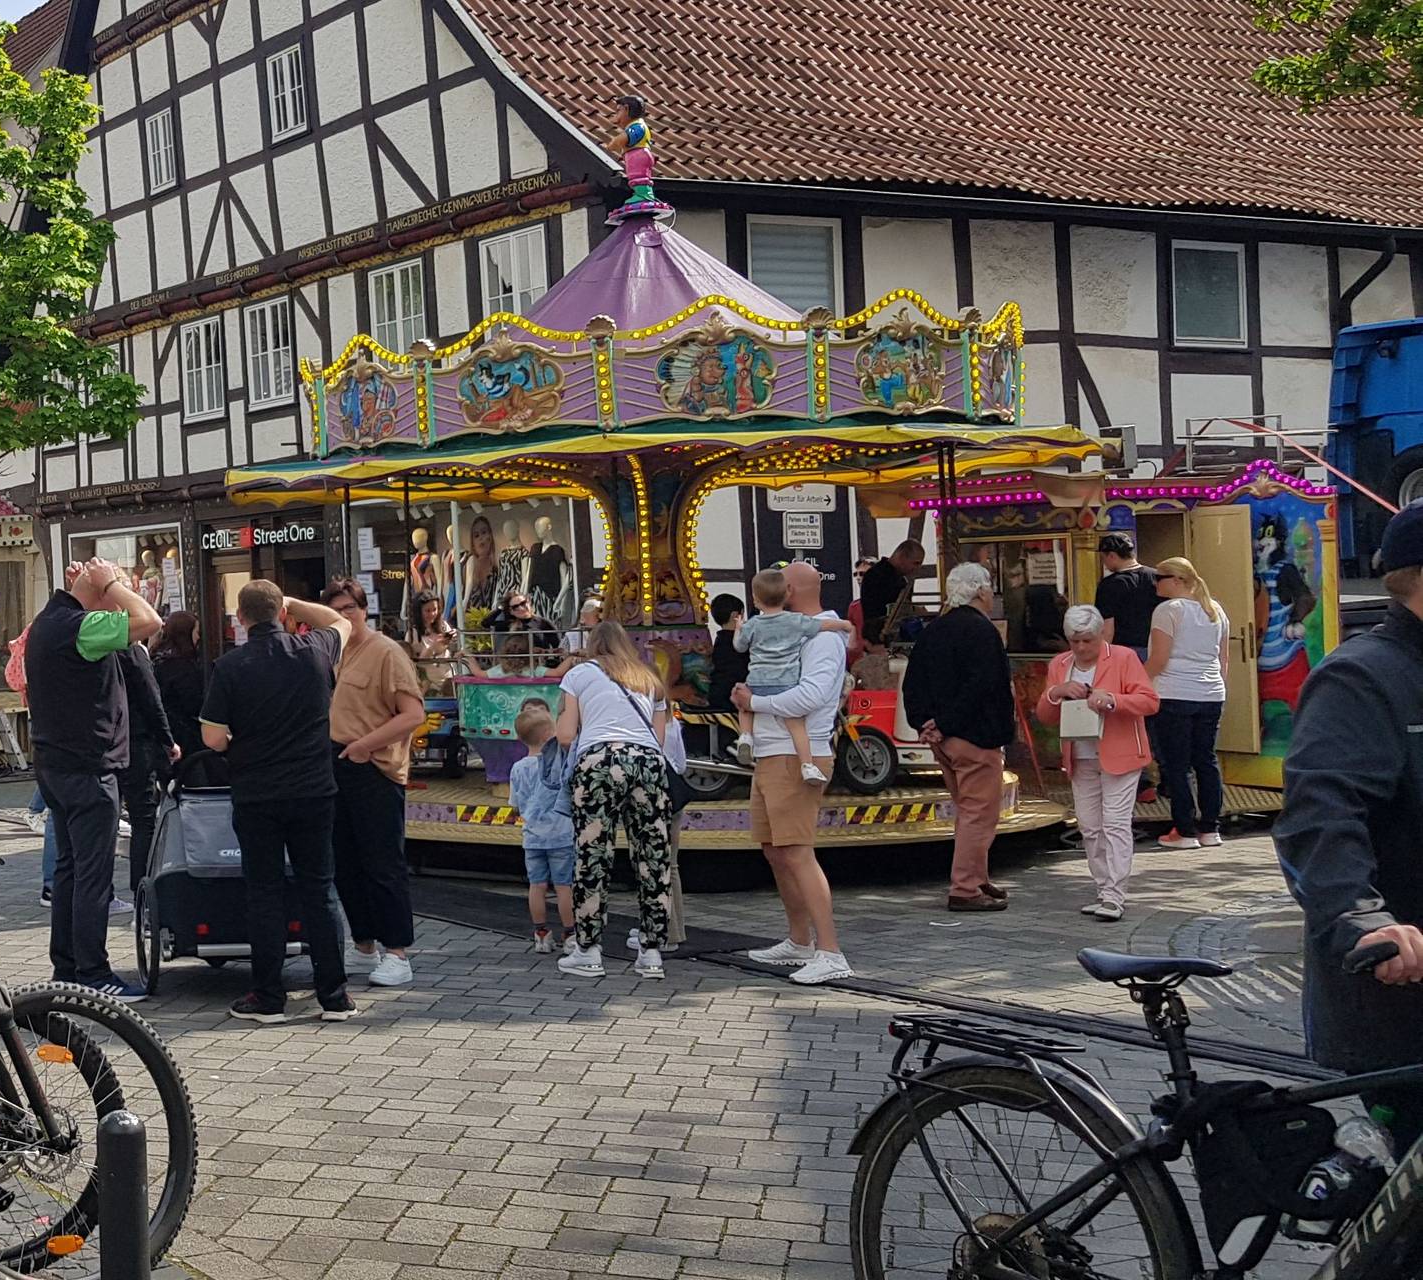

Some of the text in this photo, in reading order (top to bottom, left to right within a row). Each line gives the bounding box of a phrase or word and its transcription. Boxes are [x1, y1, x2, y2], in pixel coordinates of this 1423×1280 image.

[773, 494, 824, 503] Agentur für Arbeit
[201, 524, 315, 549] CECIL Street One
